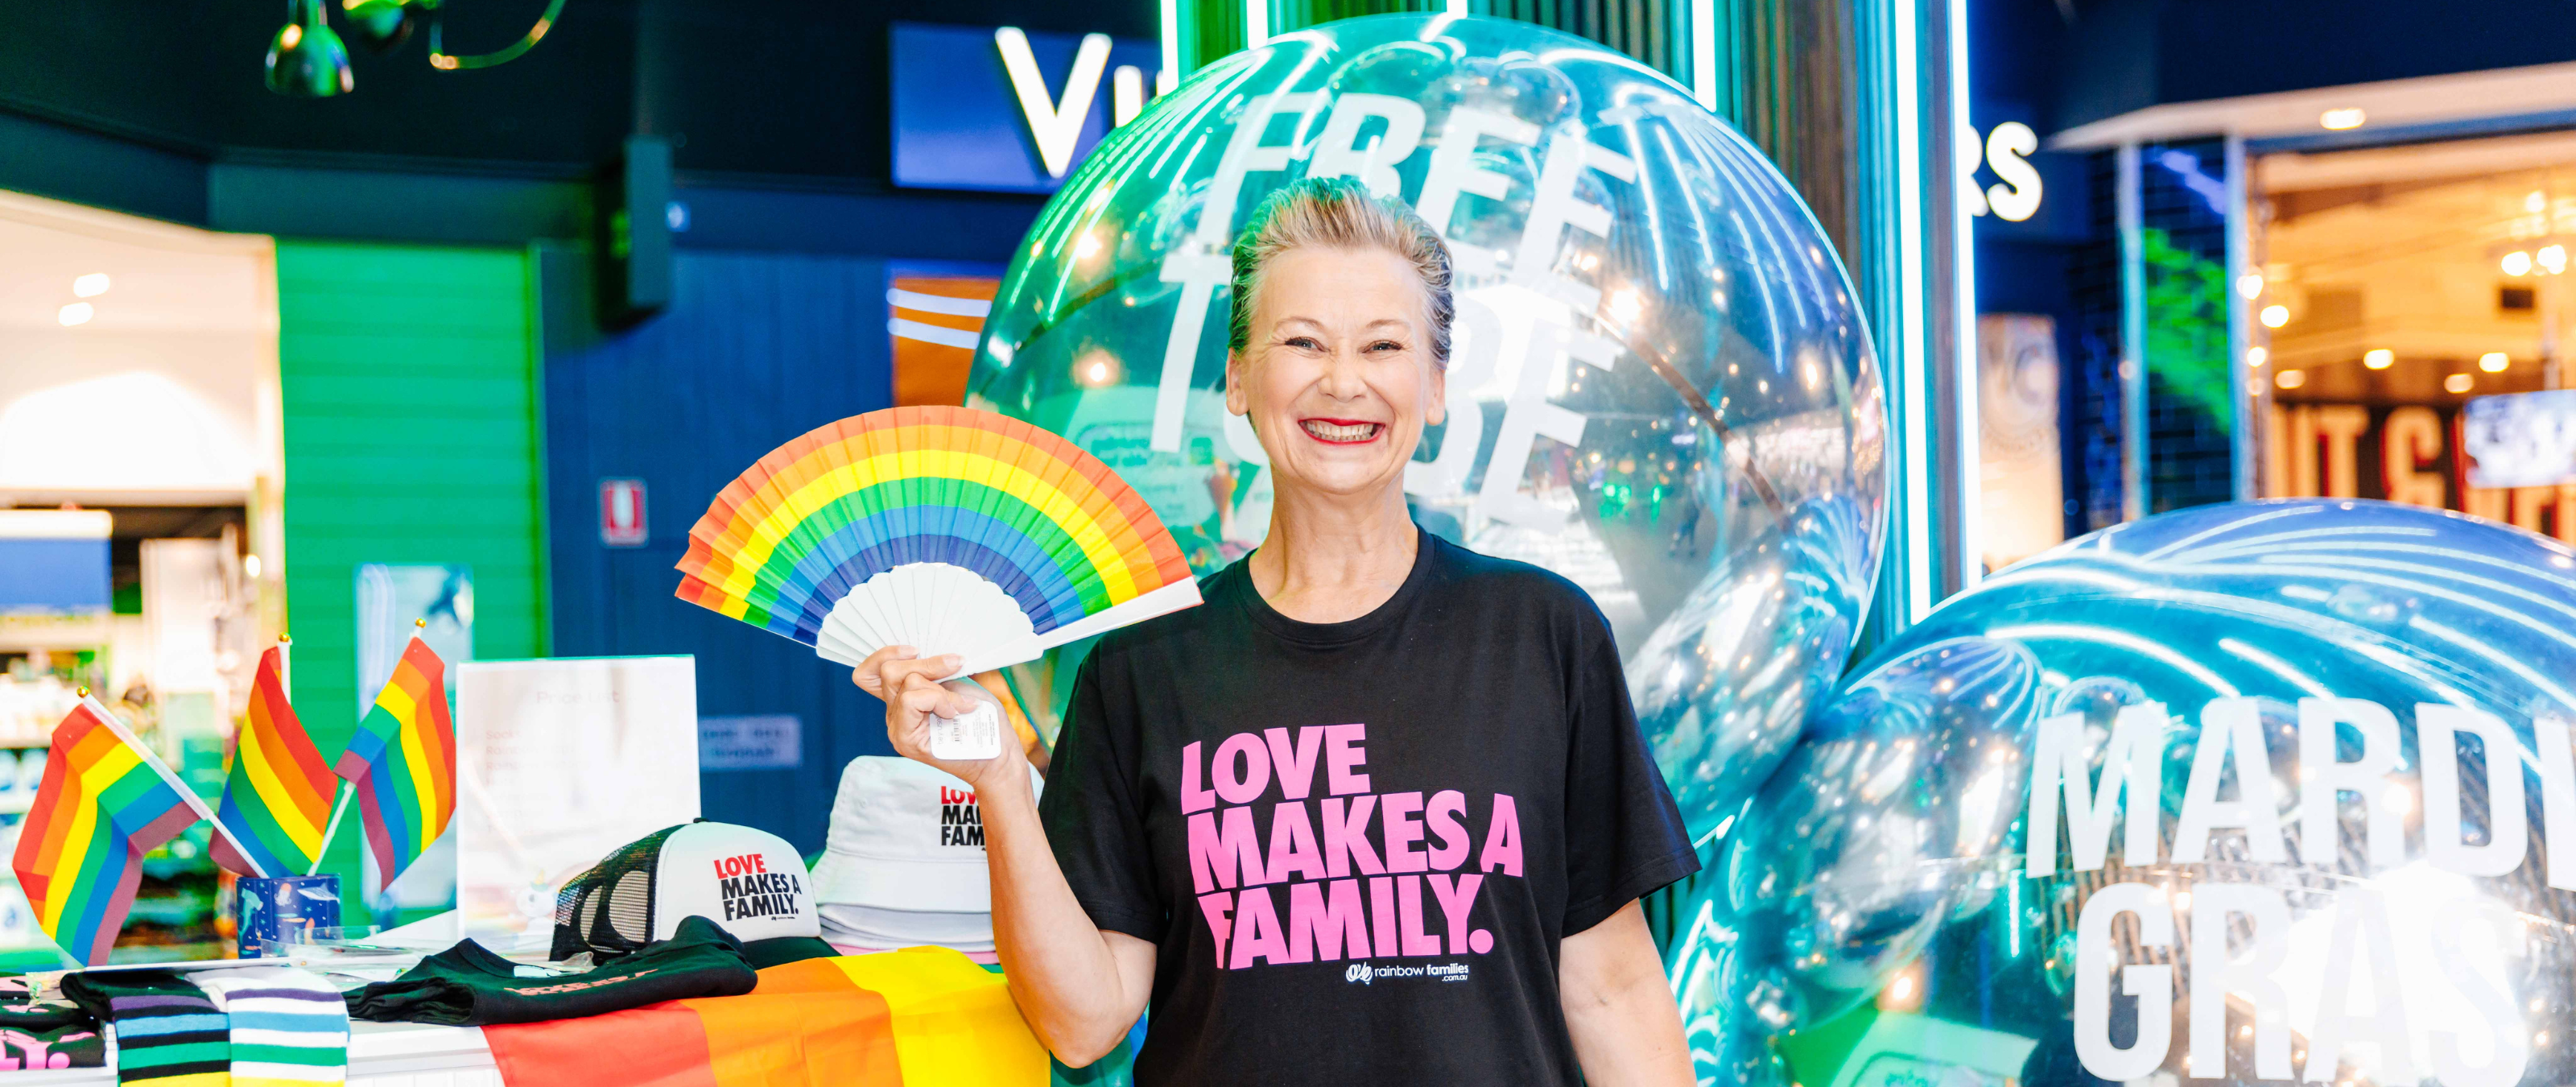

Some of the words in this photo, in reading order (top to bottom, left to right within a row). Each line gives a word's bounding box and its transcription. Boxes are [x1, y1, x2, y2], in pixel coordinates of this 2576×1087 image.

[1191, 92, 1637, 317] FREE
[536, 691, 583, 704] Price
[1181, 723, 1371, 816] LOVE
[941, 786, 977, 804] LOV
[2025, 695, 2576, 892] MARDI
[941, 805, 982, 825] MA
[941, 825, 985, 846] FAM
[1187, 790, 1471, 895] MAKES
[1480, 793, 1523, 878] A
[714, 853, 767, 879] LOVE
[720, 873, 791, 900] MAKES
[791, 874, 803, 895] A
[724, 893, 799, 922] FAMILY.
[1197, 874, 1494, 971] FAMILY.
[1374, 965, 1425, 977] rainbow
[1426, 962, 1469, 975] families
[2074, 881, 2531, 1087] GRAS
